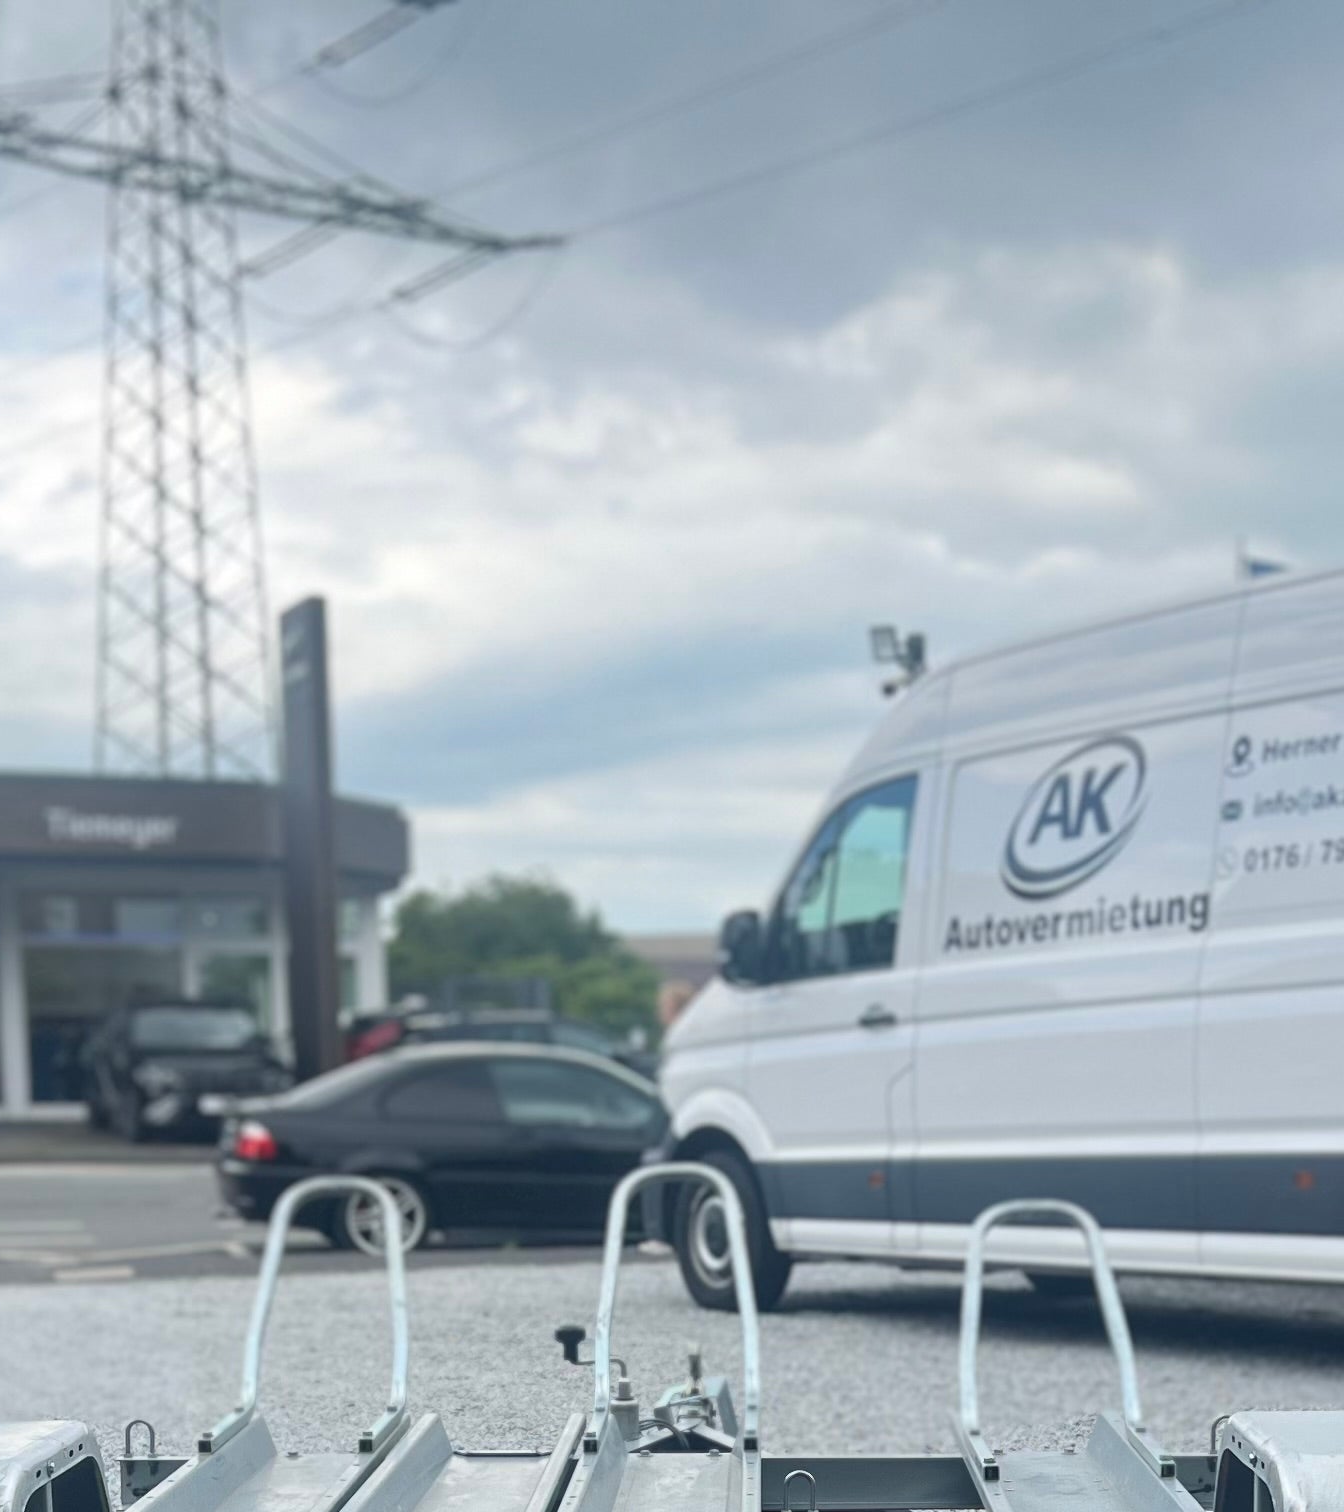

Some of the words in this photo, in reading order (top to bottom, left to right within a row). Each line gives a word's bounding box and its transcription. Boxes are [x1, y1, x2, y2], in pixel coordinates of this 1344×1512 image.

[1261, 733, 1342, 763] Herner
[1027, 761, 1128, 847] AK
[1243, 844, 1300, 872] 0176
[944, 892, 1210, 952] Autovermietung
